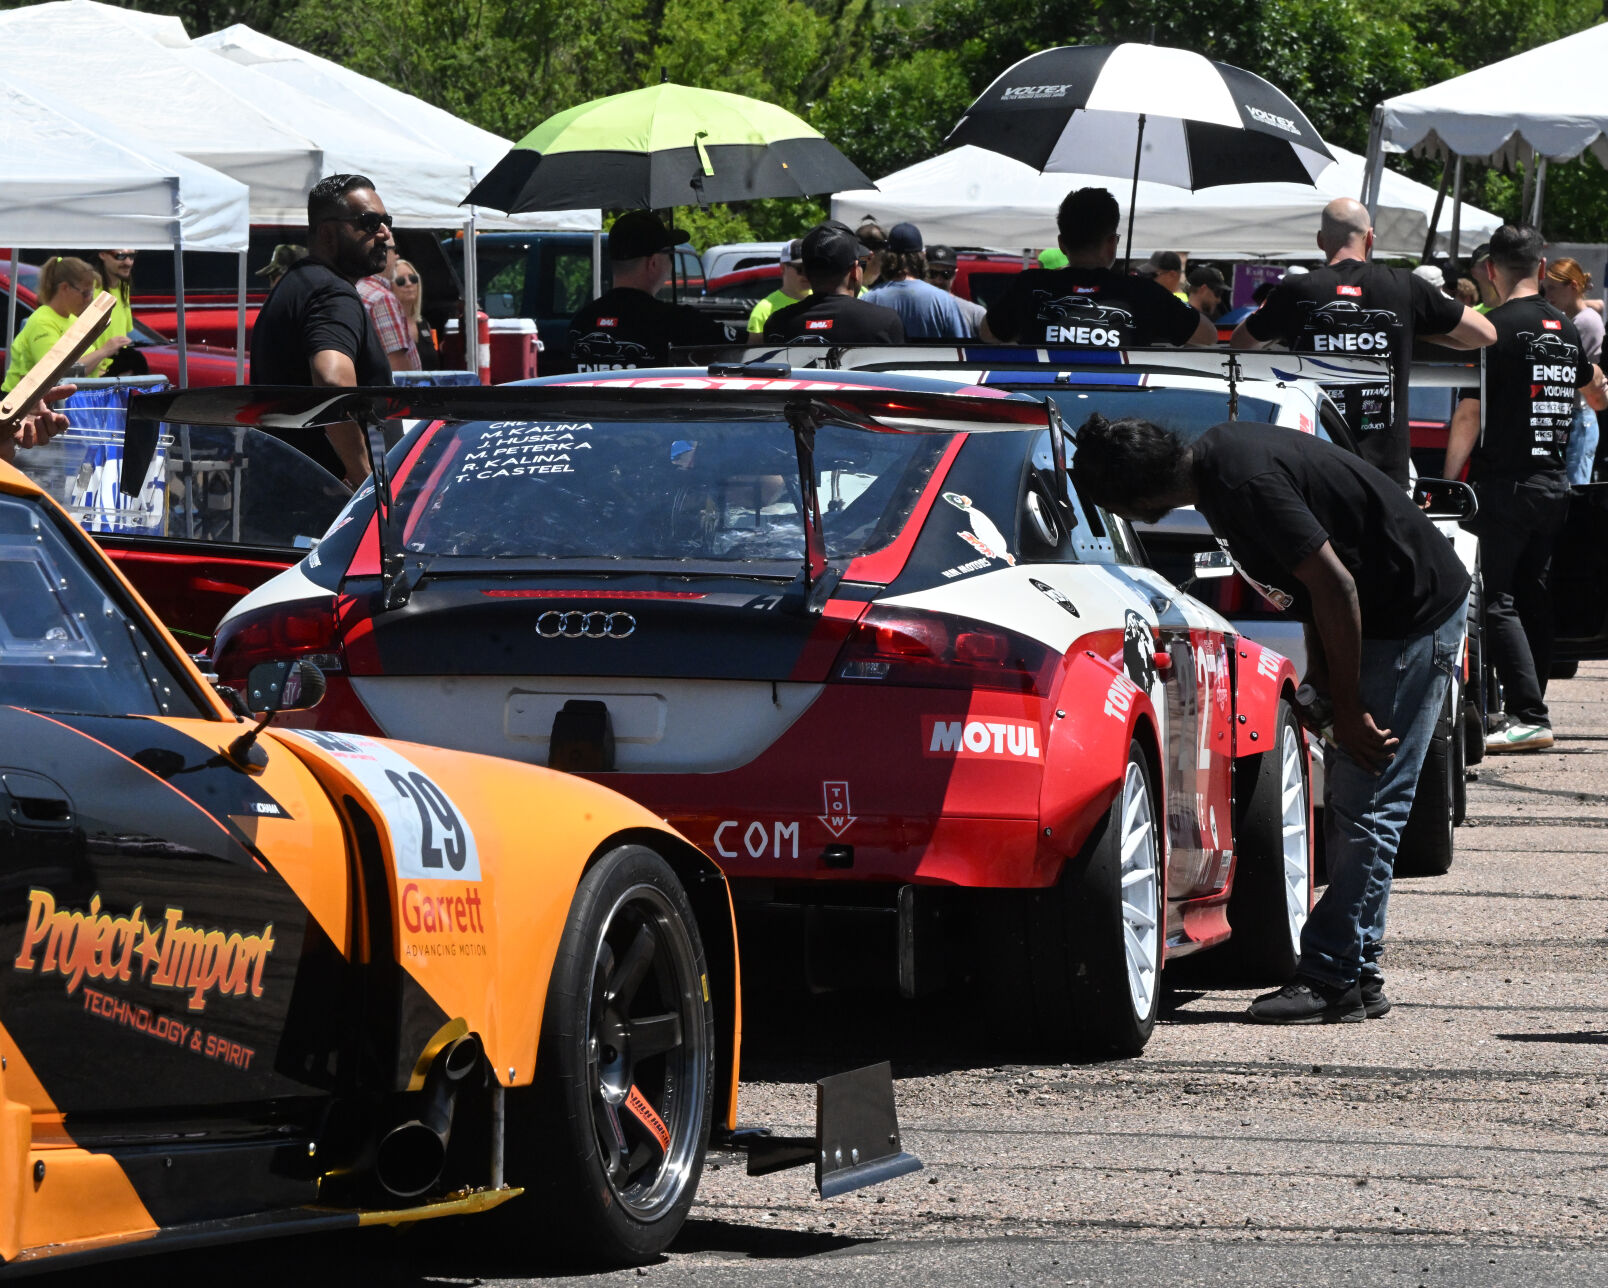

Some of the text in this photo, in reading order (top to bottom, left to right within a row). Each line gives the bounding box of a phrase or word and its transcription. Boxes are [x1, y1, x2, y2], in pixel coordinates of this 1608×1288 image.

[1004, 84, 1073, 96] VOLTEX
[1045, 325, 1120, 347] ENEOS
[1313, 331, 1388, 352] ENEOS
[1532, 364, 1577, 384] ENEOS
[477, 432, 575, 449] J. HUSKA
[480, 422, 593, 440] M. KALINA
[464, 441, 593, 461] M. PETERKA
[455, 464, 575, 483] T. CASTEEL
[462, 453, 571, 473] R. KALINA
[929, 721, 1040, 758] MOTUL
[831, 787, 844, 827] TOW
[384, 768, 467, 872] 29
[713, 820, 799, 859] COM
[401, 882, 485, 934] Garrett
[14, 889, 275, 1010] Project Import
[405, 943, 488, 957] ADVANCING MOTION
[83, 988, 255, 1070] TECHNOLOGY & SPIRIT
